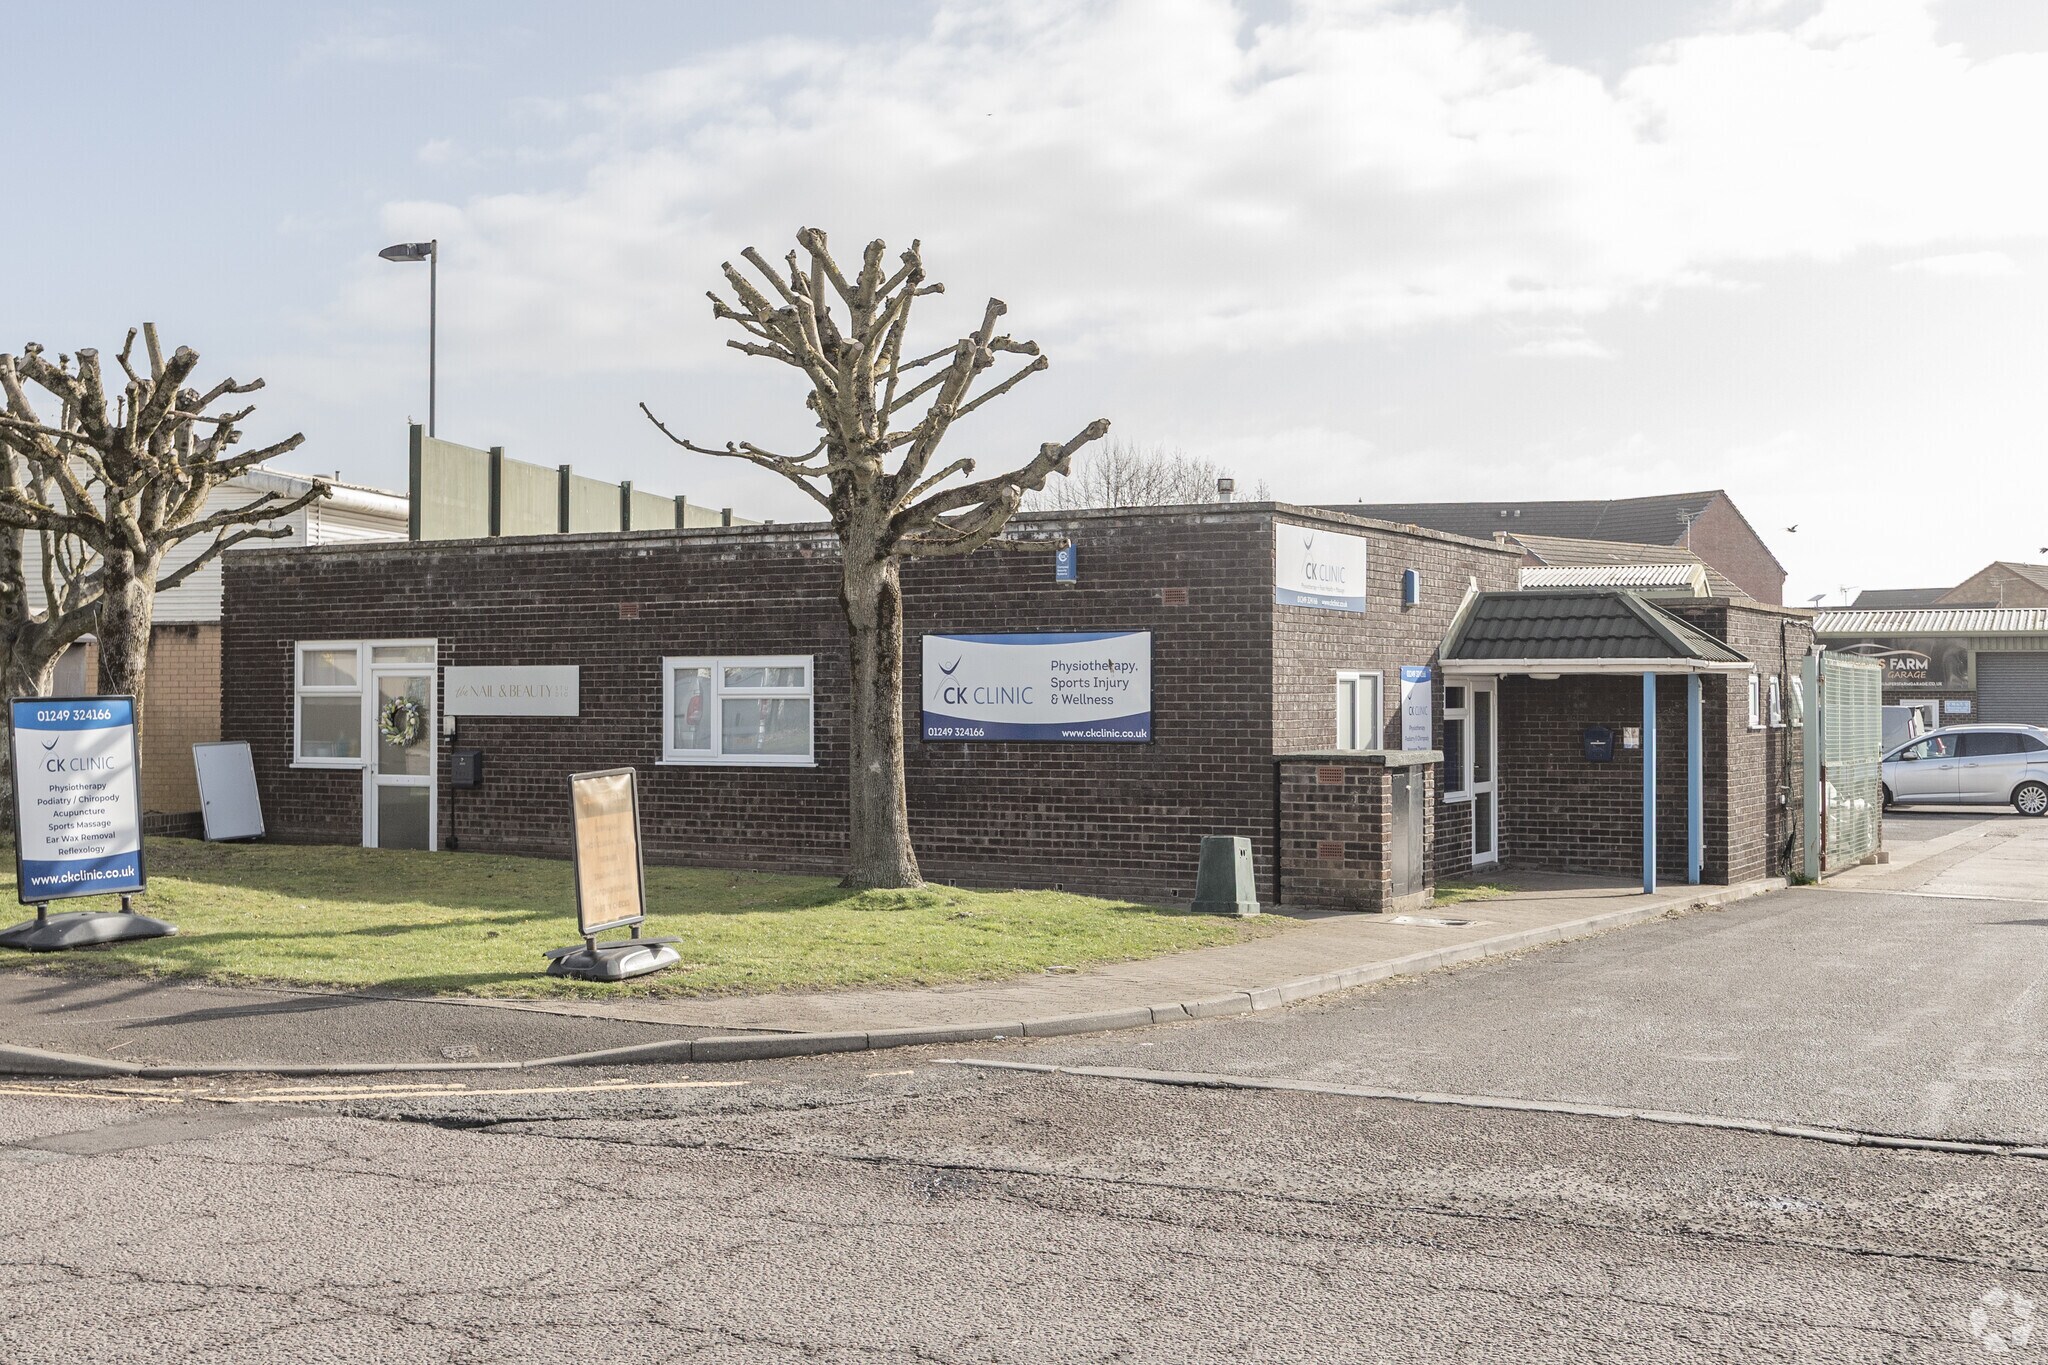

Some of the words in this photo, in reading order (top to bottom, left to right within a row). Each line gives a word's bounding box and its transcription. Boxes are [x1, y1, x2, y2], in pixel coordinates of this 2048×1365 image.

[1306, 562, 1317, 580] CK
[1319, 564, 1346, 584] CLINIC
[1051, 660, 1138, 674] Physiotheapy,
[1890, 658, 1928, 670] FARM
[1050, 677, 1090, 691] Sports
[1093, 677, 1129, 691] Injury
[470, 685, 495, 698] NAIL
[498, 685, 507, 698] &
[509, 685, 552, 698] BEAUTY
[943, 687, 968, 704] CK
[973, 686, 1034, 705] CLINIC
[1051, 694, 1058, 705] &
[1061, 694, 1114, 705] Wellness
[38, 710, 69, 722] 01249
[73, 709, 111, 721] 324166
[928, 728, 953, 737] 01249
[955, 728, 985, 737] 324166
[1062, 728, 1147, 738] www.ckclinic.co.uk
[47, 758, 66, 772] CK
[70, 756, 114, 771] CLINIC
[49, 782, 106, 793] Physiotherapy
[37, 797, 72, 807] Podiatry
[73, 796, 77, 804] /
[78, 794, 120, 805] Chiropody
[53, 807, 105, 818] Acupuncture
[48, 822, 74, 832] Sports
[76, 819, 111, 830] Massage
[46, 835, 59, 844] Ear
[61, 834, 79, 842] Wax
[81, 831, 116, 841] Removal
[58, 845, 105, 856] Reflexology
[32, 865, 135, 886] www.ckclinic.co.uk
